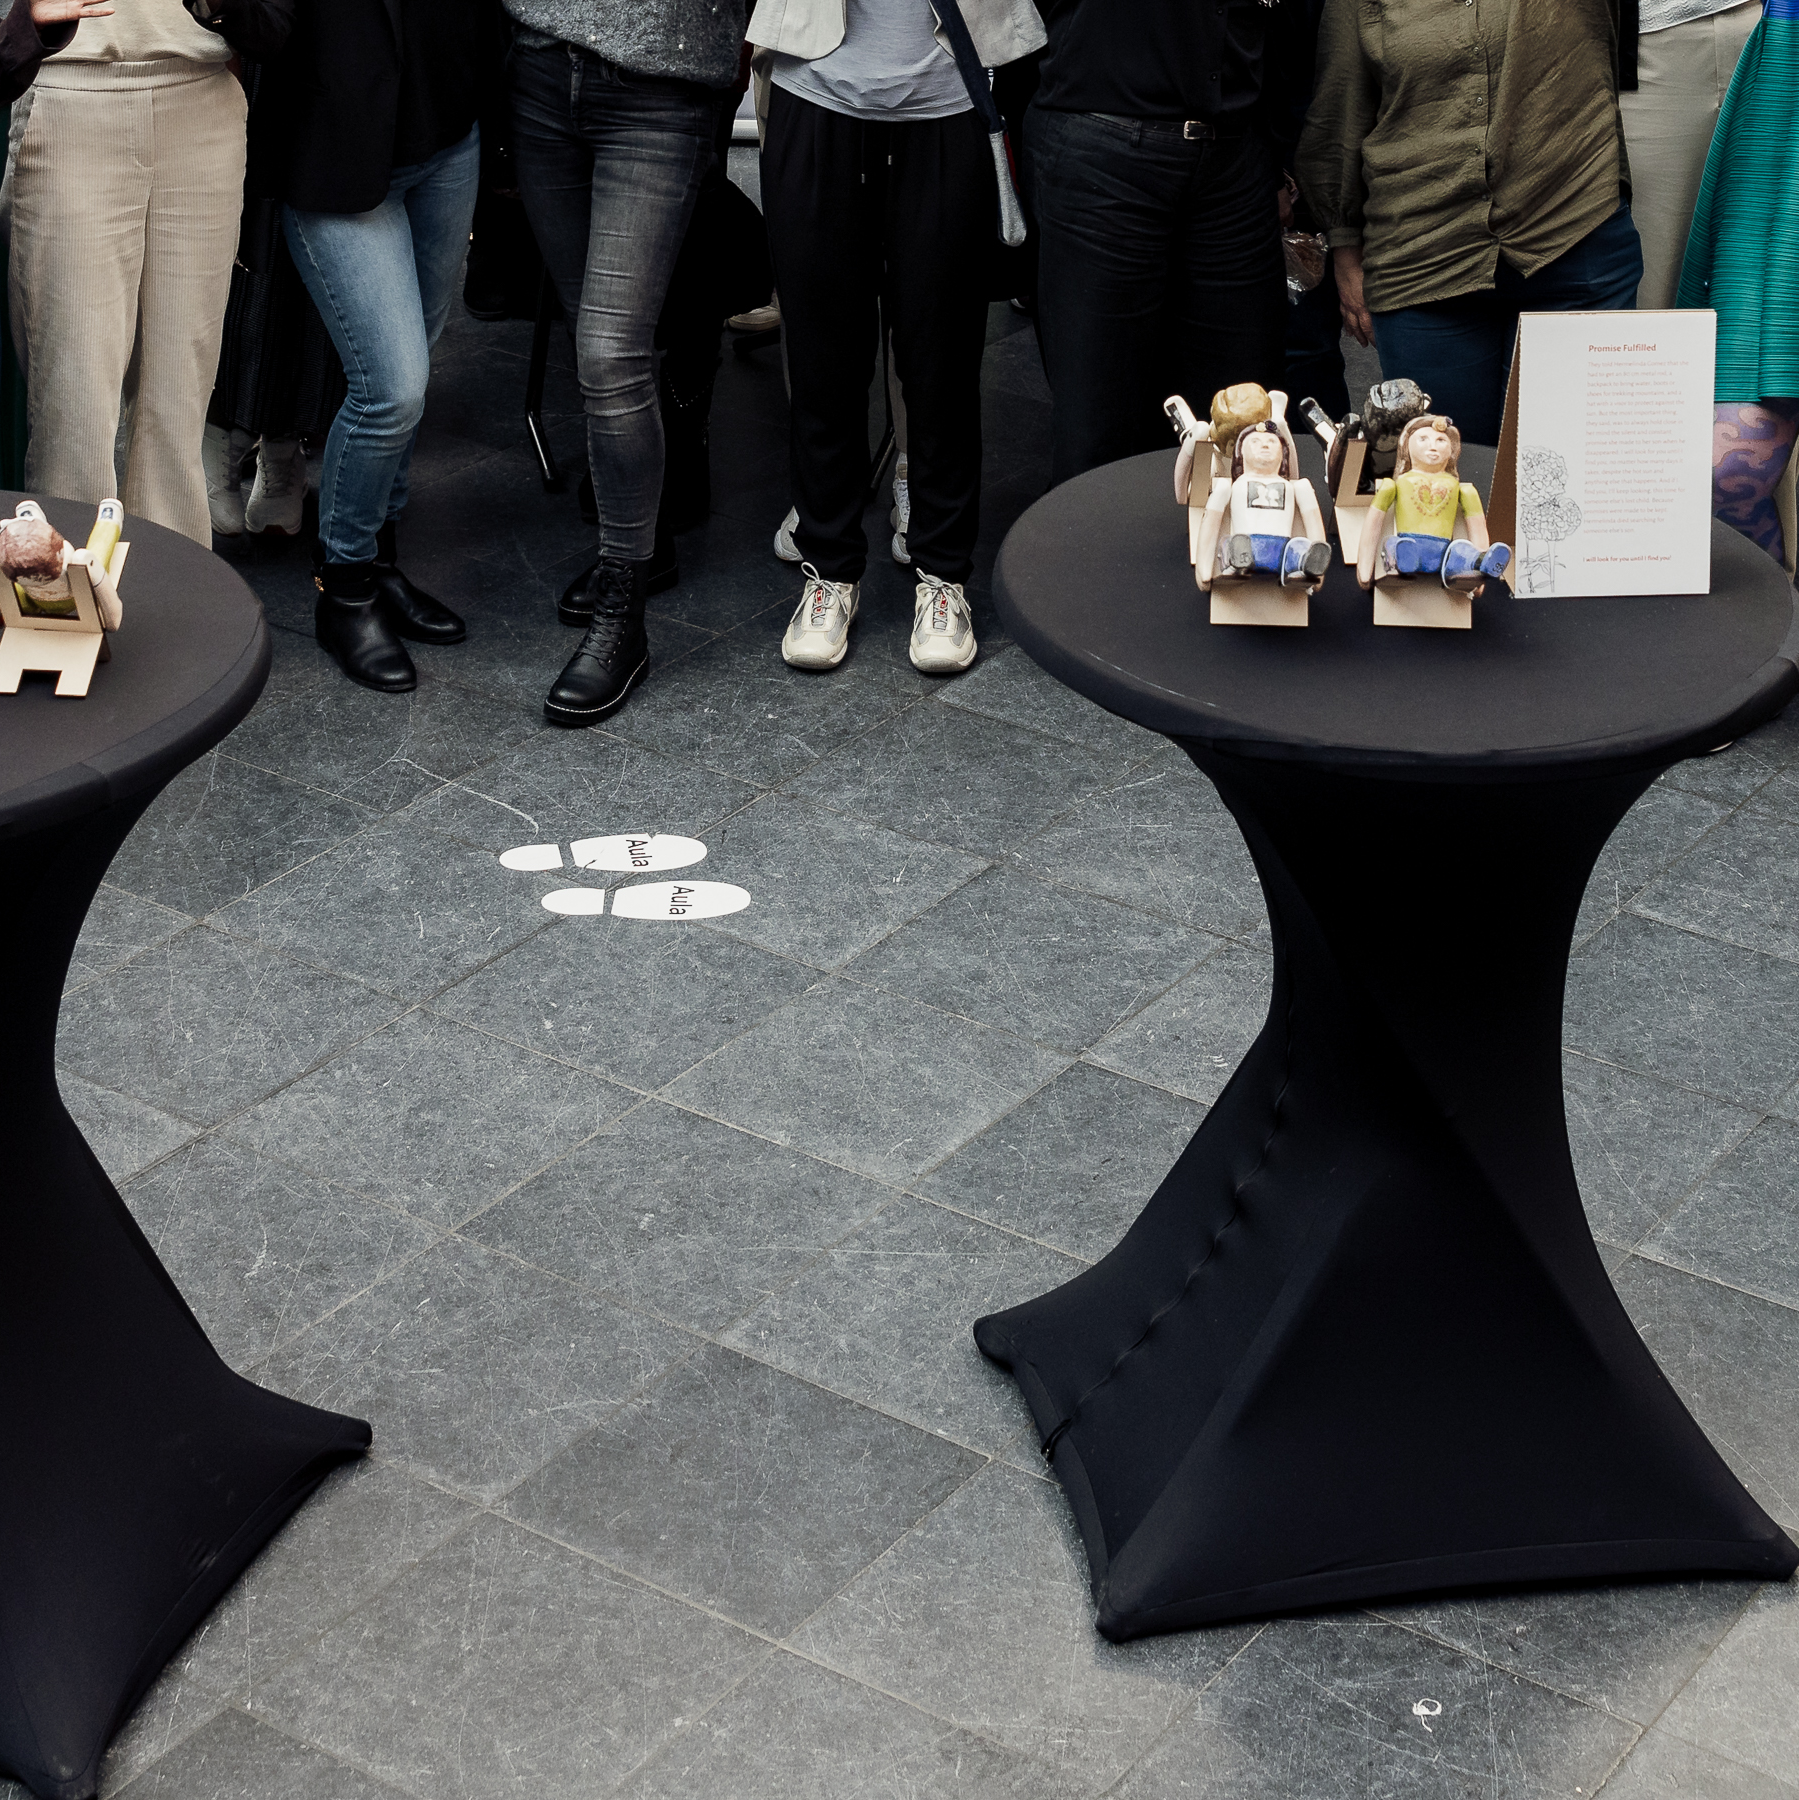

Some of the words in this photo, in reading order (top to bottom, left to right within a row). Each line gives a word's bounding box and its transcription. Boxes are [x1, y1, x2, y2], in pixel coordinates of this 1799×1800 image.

[1589, 344, 1621, 352] Promise
[1623, 344, 1657, 352] Fulfilled
[625, 839, 649, 868] Aula
[669, 886, 695, 916] Aula
